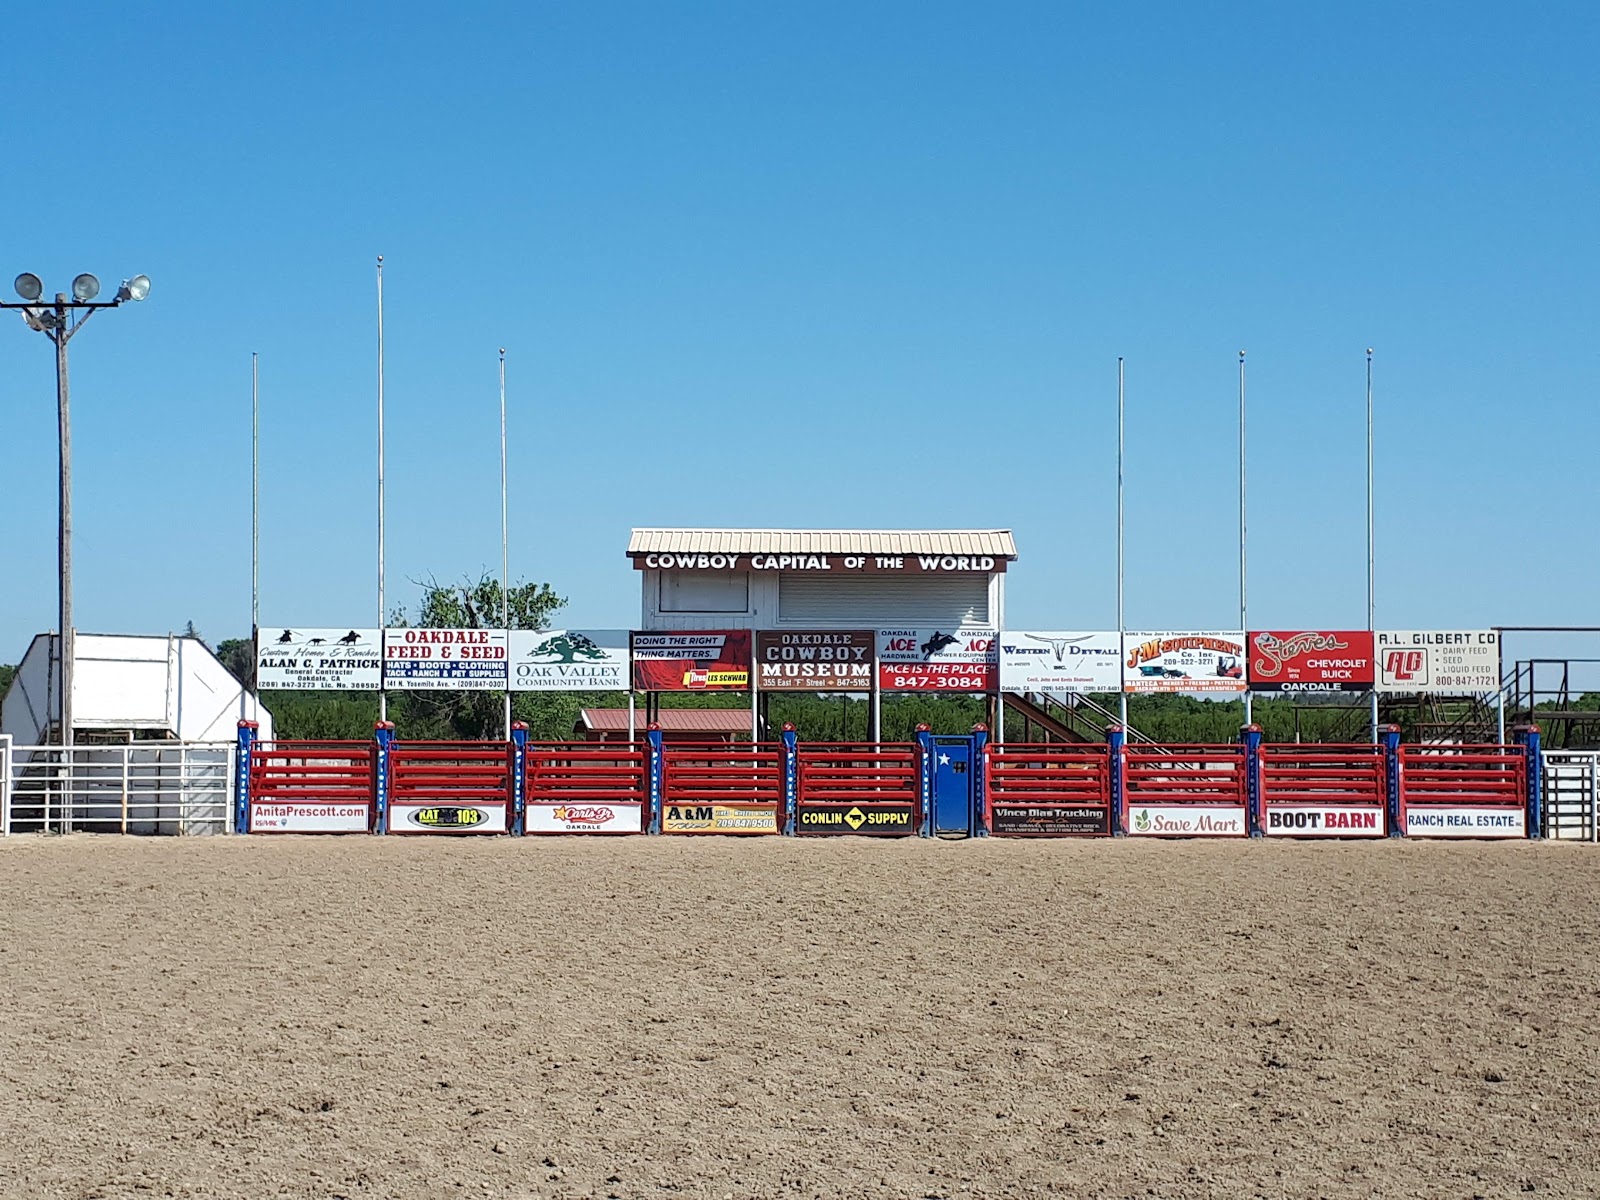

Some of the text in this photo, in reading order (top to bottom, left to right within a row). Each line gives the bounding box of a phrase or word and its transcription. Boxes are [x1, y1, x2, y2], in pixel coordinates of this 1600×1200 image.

[646, 554, 995, 570] COWBOY CAPITAL OF THE WORLD
[405, 631, 488, 643] OAKDALE
[782, 634, 852, 644] OAKDALE
[1379, 634, 1495, 644] A.L. GILBERT CO
[884, 637, 917, 651] ACE
[964, 638, 996, 652] ACE
[260, 647, 379, 657] Custom Homes & Ranches
[387, 646, 505, 659] FEED & SEED
[766, 647, 867, 660] COWBOY
[1002, 646, 1119, 655] WESTERN DRYWALL
[260, 659, 380, 668] ALAN C. PATRICK
[1307, 659, 1367, 668] CHEVROLET
[517, 665, 620, 677] OAK VALLEY
[762, 663, 871, 676] MUSEUM
[912, 665, 923, 673] IS
[926, 665, 949, 674] THE
[1322, 670, 1352, 678] BUICK
[517, 678, 585, 686] COMMUNITY
[894, 677, 983, 687] 847-3084
[255, 806, 364, 816] AnitaPrescott.com
[419, 810, 477, 823] KAT 103
[564, 808, 596, 820] Carl's
[996, 809, 1026, 817] Vince
[1055, 809, 1103, 819] Trucking
[802, 813, 909, 824] CONLIN SUPPLY
[1154, 815, 1239, 832] Save Mart
[1270, 812, 1376, 828] BOOT BARN
[1408, 815, 1443, 826] RANCH
[1447, 815, 1473, 826] REAL
[1477, 816, 1514, 826] ESTATE
